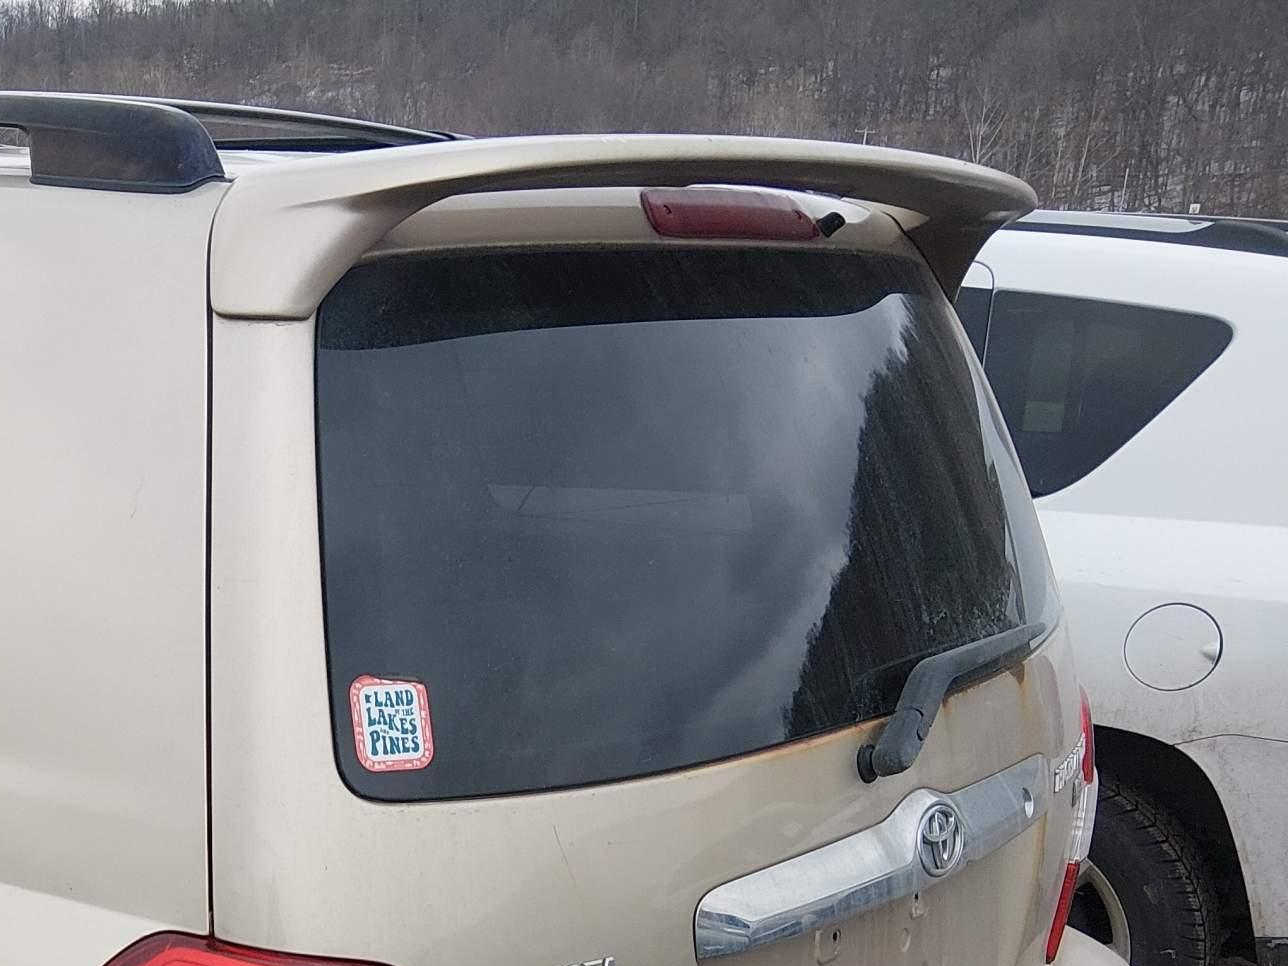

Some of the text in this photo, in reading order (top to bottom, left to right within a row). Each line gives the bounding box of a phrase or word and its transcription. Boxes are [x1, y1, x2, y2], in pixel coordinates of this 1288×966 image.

[373, 689, 414, 708] LAND
[366, 707, 418, 735] LAKES
[369, 730, 420, 756] PINES
